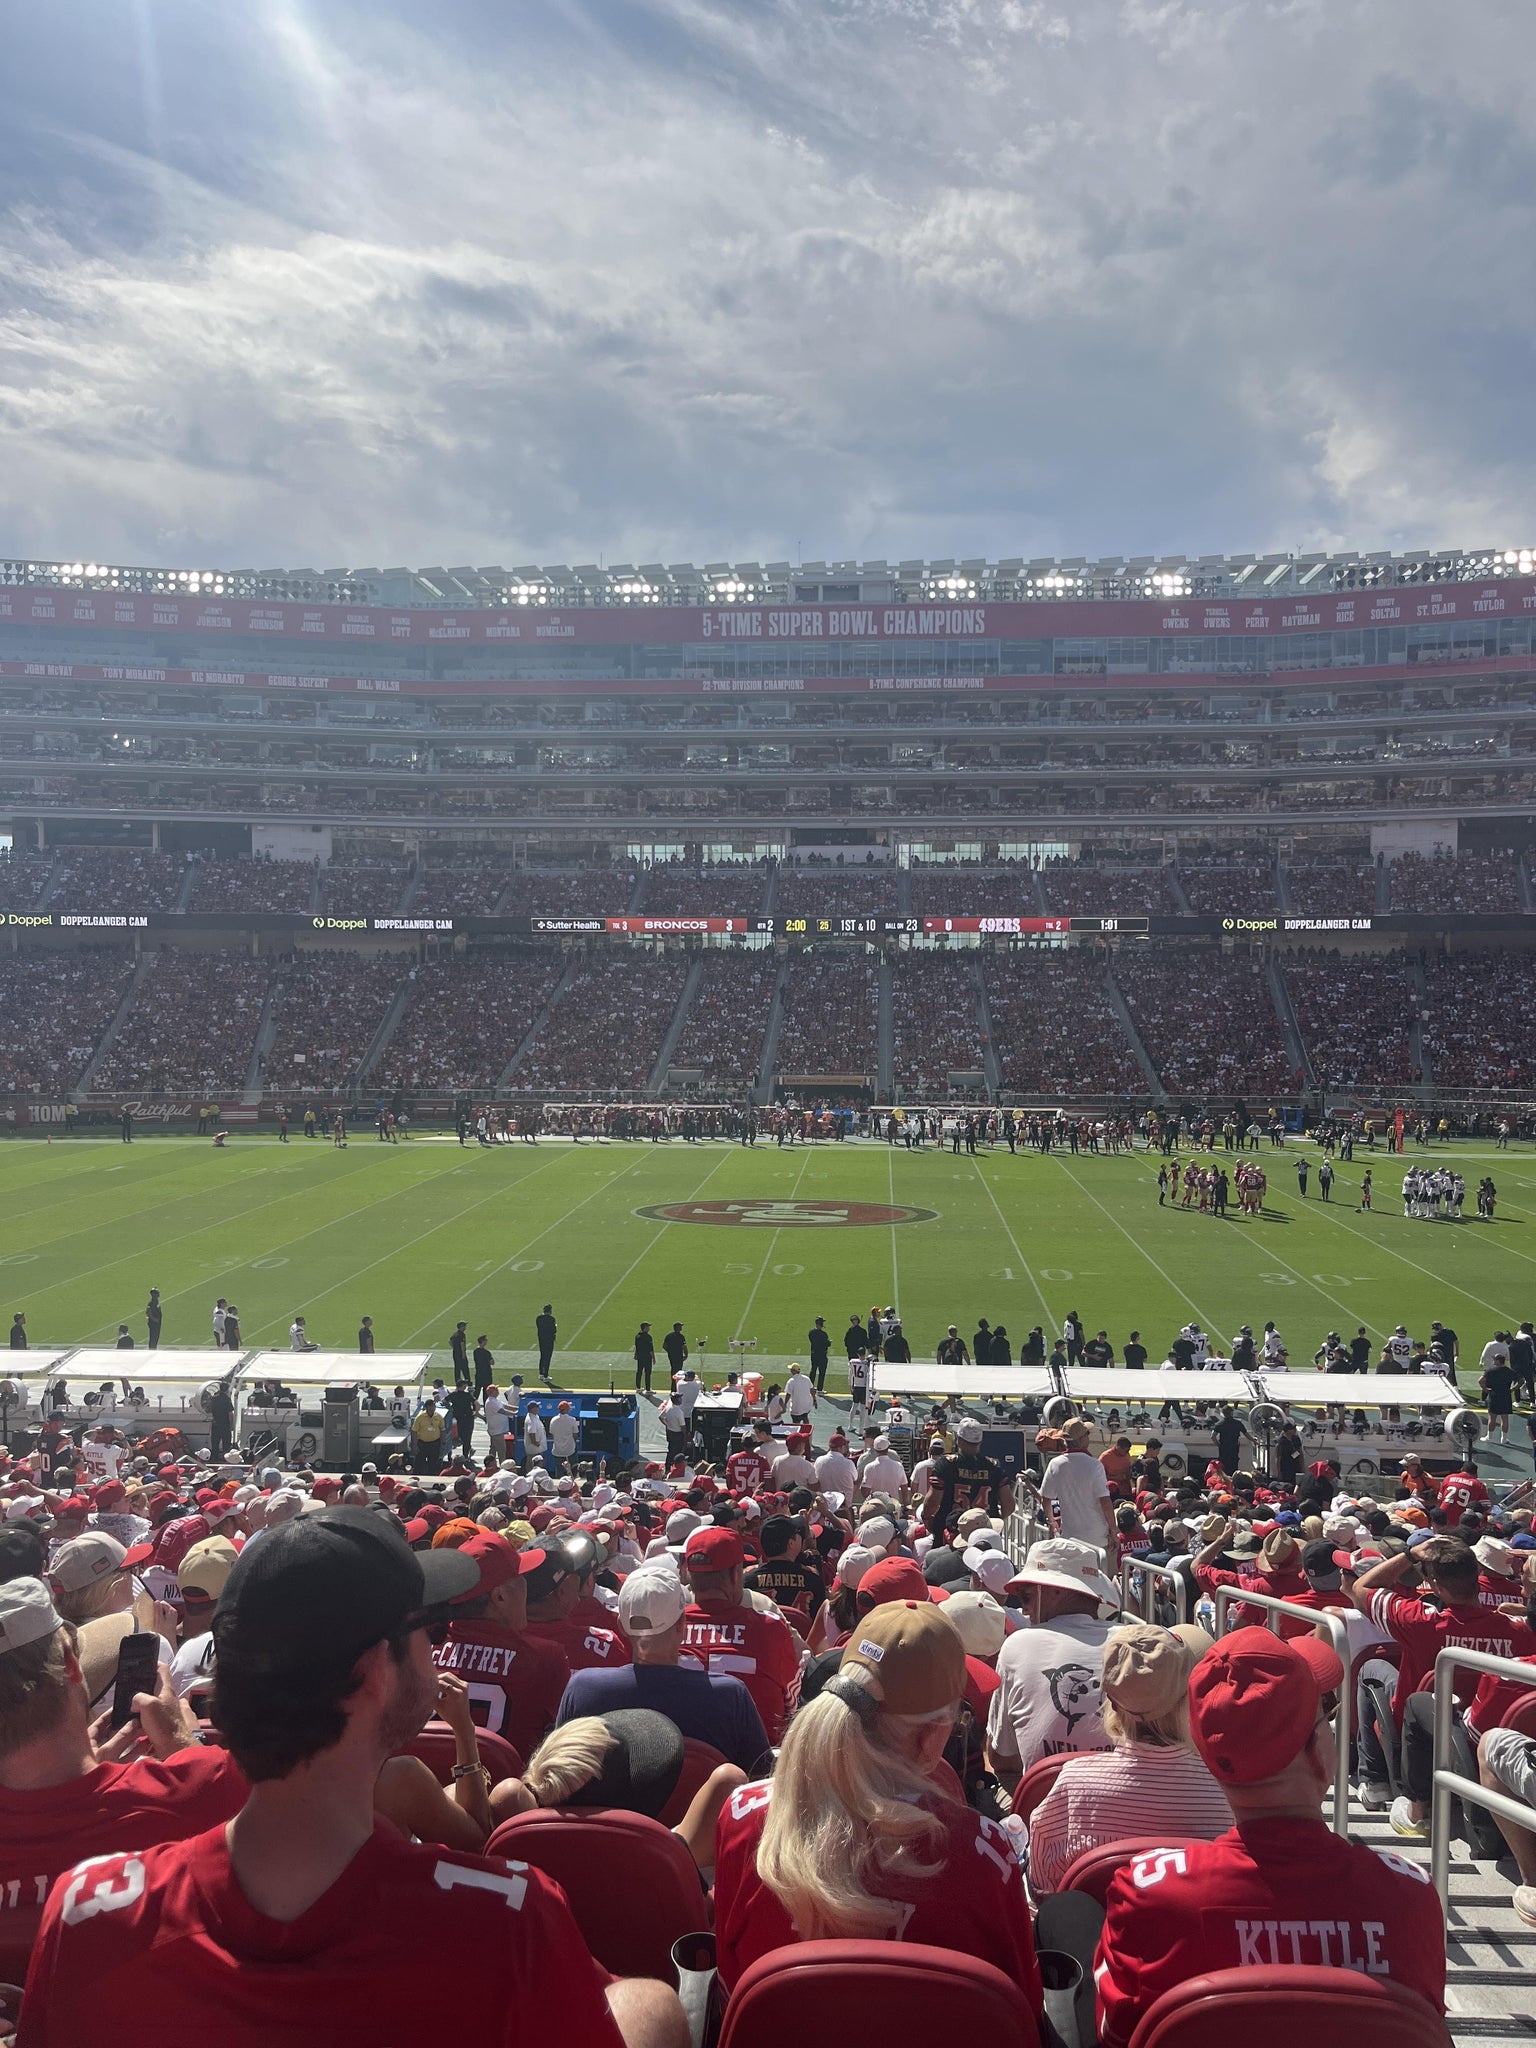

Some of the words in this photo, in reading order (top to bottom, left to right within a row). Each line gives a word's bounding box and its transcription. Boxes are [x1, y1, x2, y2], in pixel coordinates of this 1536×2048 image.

[1416, 605, 1430, 617] ST.
[1431, 602, 1456, 616] CLAIR
[1472, 599, 1505, 612] TAYLOR
[1282, 613, 1320, 627] RATHMAN
[1336, 610, 1354, 623] RICE
[1370, 607, 1400, 620] SOLTAU
[703, 612, 762, 637] 5-TIME
[768, 611, 823, 637] SUPER
[828, 611, 878, 636] BOWL
[883, 609, 985, 635] CHAMPIONS
[1162, 617, 1189, 629] OWENS
[1203, 617, 1230, 628] OWENS
[1245, 617, 1269, 628] PERRY
[24, 663, 46, 675] JOHN
[47, 664, 73, 676] McVAY
[103, 666, 124, 678] TONY
[125, 668, 166, 680] MORABITO
[191, 671, 204, 682] VIC
[205, 672, 245, 684] MORABITO
[268, 675, 297, 687] GEORGE
[298, 677, 329, 688] SEIFERT
[895, 678, 942, 689] CONFERENCE
[943, 678, 984, 688] CHAMPIONS
[357, 679, 374, 690] BILL
[375, 680, 400, 691] WALSH
[702, 680, 731, 690] 22-TIME
[732, 680, 762, 690] DIVISION
[763, 680, 805, 690] CHAMPIONS
[8, 915, 53, 927] Doppel
[60, 916, 127, 926] DOPPELGANGER
[129, 916, 148, 926] CAM
[327, 918, 367, 930] Doppel
[374, 919, 434, 929] DOPPELGANGER
[435, 920, 452, 929] CAM
[546, 920, 572, 930] Sutter
[573, 920, 601, 930] Health
[622, 921, 628, 931] 3
[644, 920, 708, 930] BRONCOS
[726, 920, 733, 931] 3
[767, 920, 774, 931] 2
[786, 919, 807, 931] 2:00
[820, 921, 829, 930] 25
[840, 920, 857, 931] 1ST
[858, 923, 864, 931] &
[866, 920, 876, 931] 10
[906, 920, 917, 931] 23
[945, 920, 952, 931] 0
[978, 918, 1021, 932] 49ERS
[1055, 921, 1062, 930] 2
[1100, 919, 1118, 930] 1:01
[1236, 919, 1277, 931] Doppel
[1284, 919, 1350, 930] DOPPELGANGER
[1351, 919, 1371, 929] CAM
[28, 1105, 78, 1123] HOM
[120, 1102, 192, 1122] Faithful
[722, 1262, 806, 1276] 50
[988, 1267, 1075, 1281] 40
[1257, 1271, 1354, 1288] 30
[1393, 1343, 1410, 1356] 52
[853, 1364, 864, 1378] 16
[86, 1452, 105, 1460] KITTLE
[734, 1465, 760, 1493] 54
[952, 1484, 992, 1511] 54
[1444, 1486, 1471, 1507] 29
[757, 1574, 805, 1588] WARNER
[164, 1583, 182, 1599] NIX
[681, 1624, 746, 1645] ITTLE
[431, 1641, 517, 1677] cCAFFREY
[1235, 1919, 1390, 1973] KITTLE
